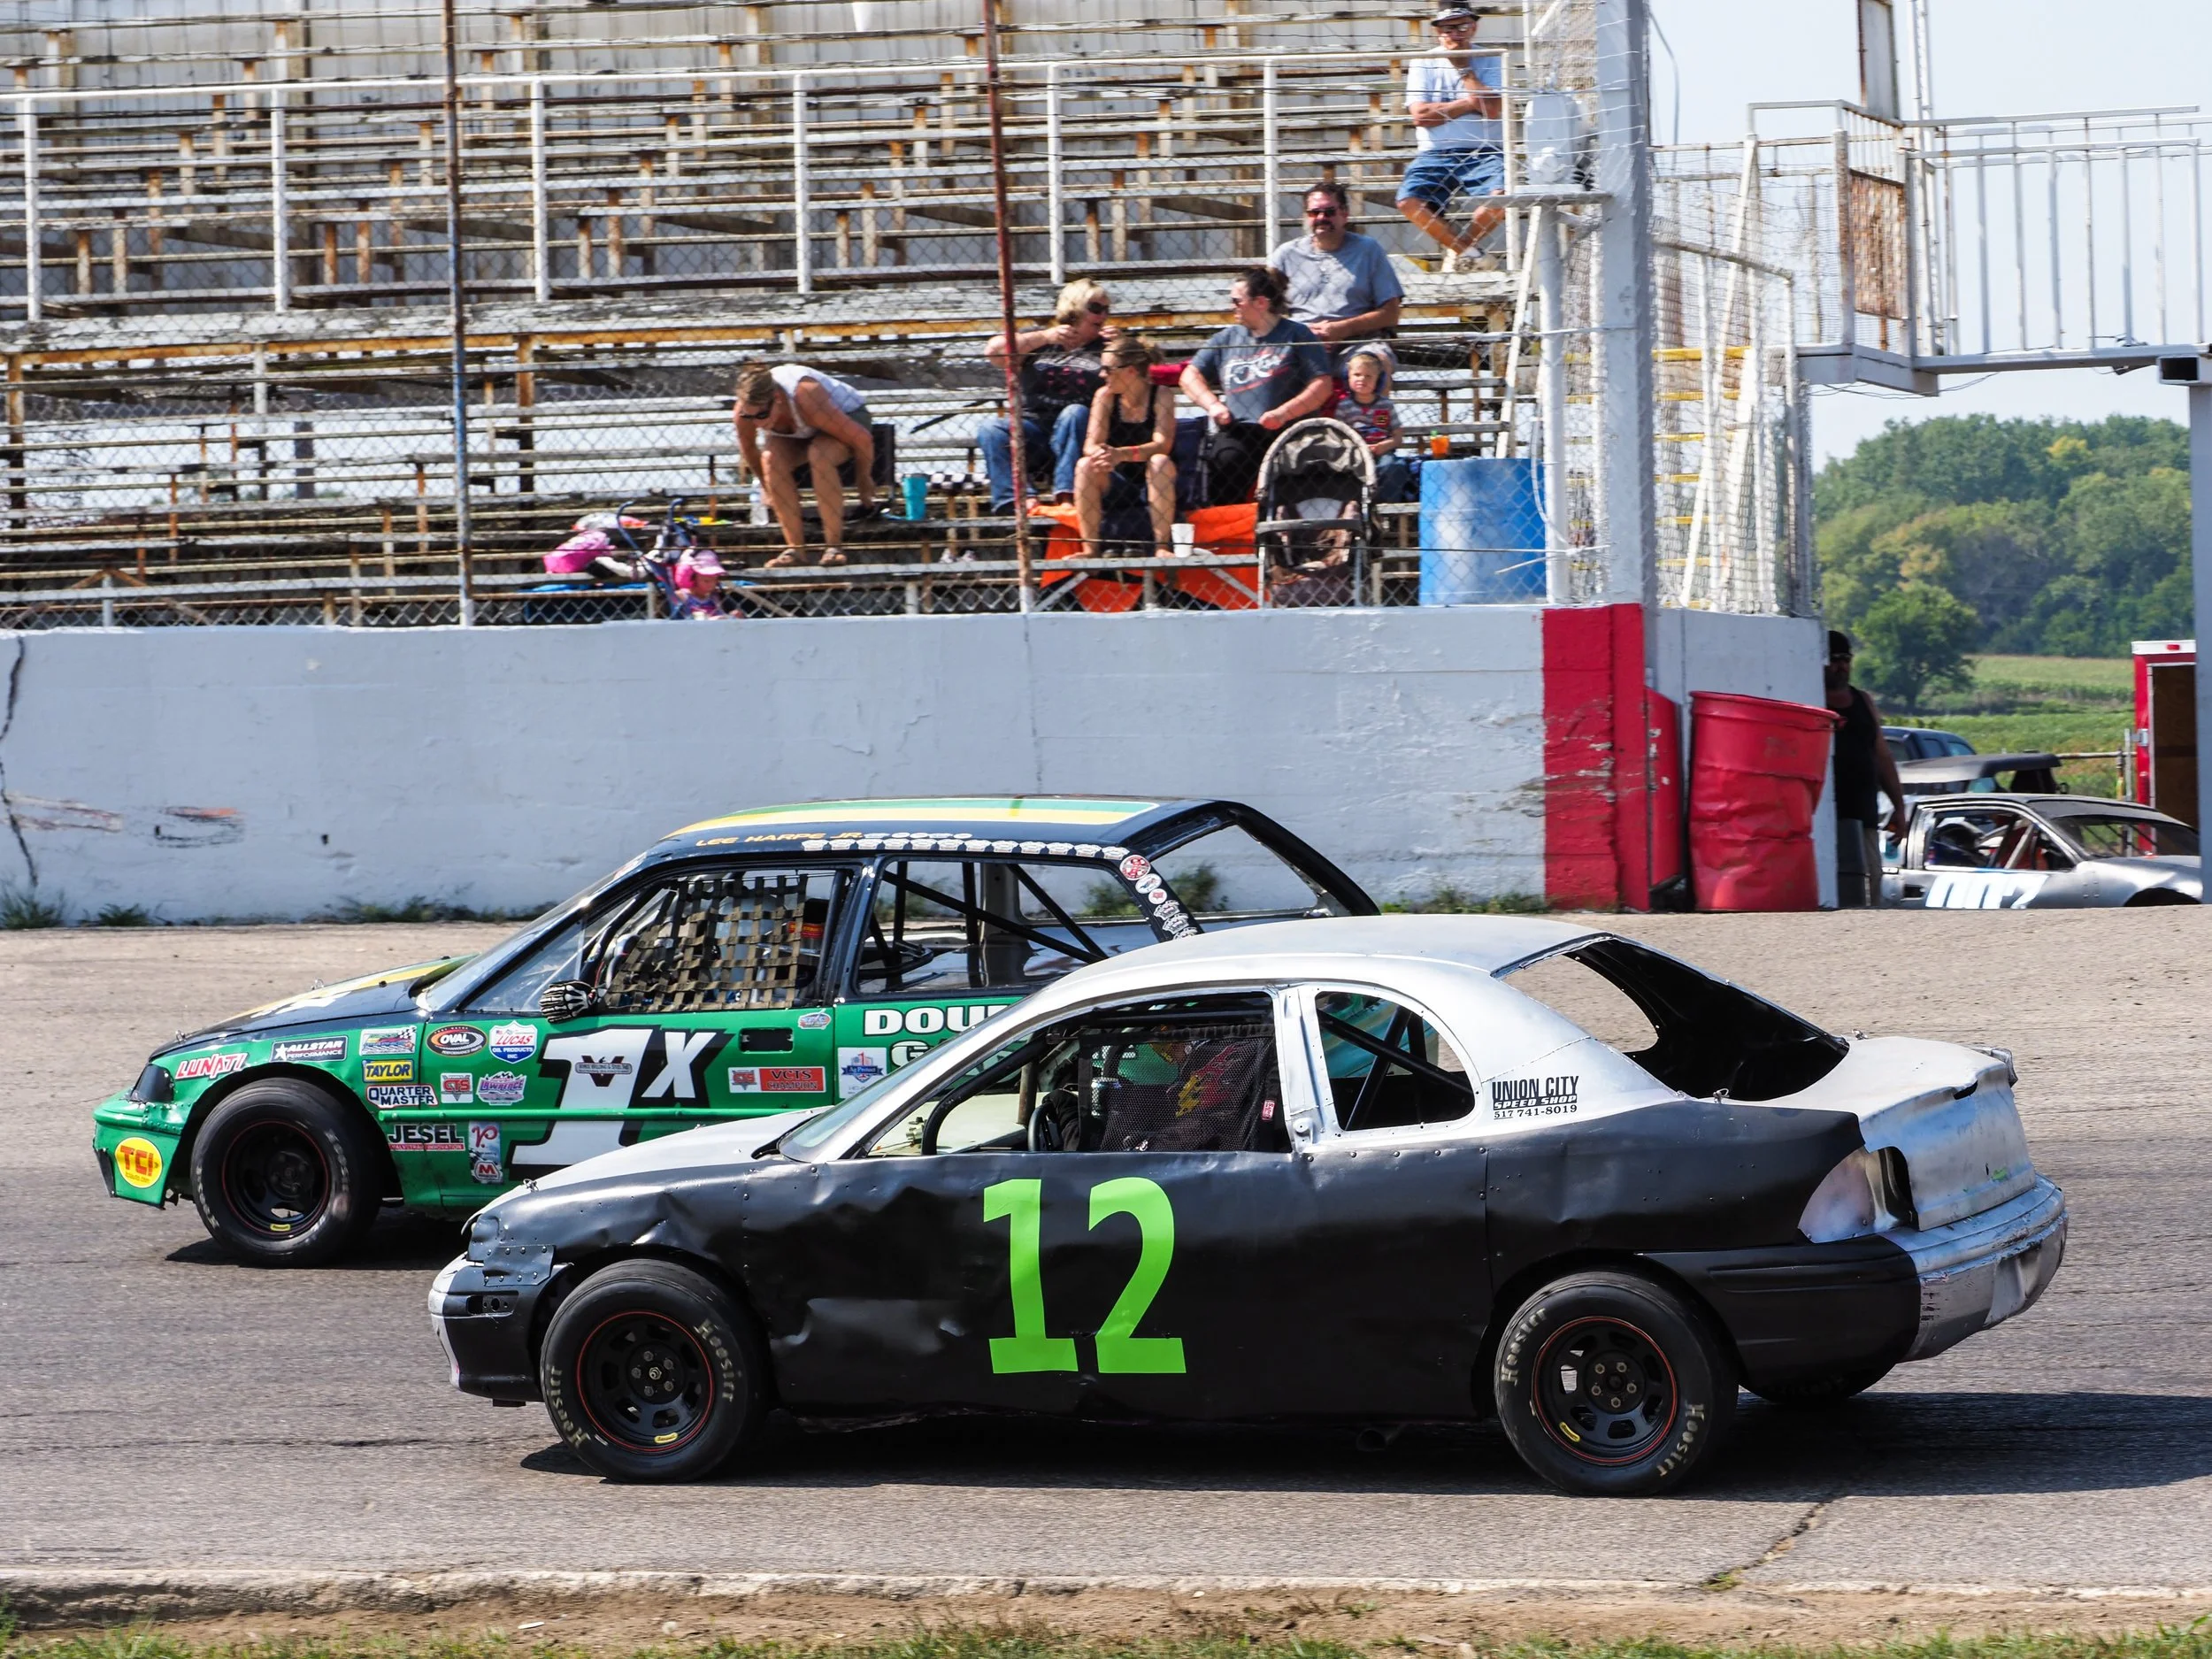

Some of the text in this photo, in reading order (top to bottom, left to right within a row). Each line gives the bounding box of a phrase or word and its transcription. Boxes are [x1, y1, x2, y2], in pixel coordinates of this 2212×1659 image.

[695, 836, 739, 847] LEE
[743, 833, 827, 842] HARPE
[864, 1005, 1008, 1035] DOU
[440, 1033, 470, 1044] OVAL
[495, 1035, 534, 1045] LUCAS
[287, 1040, 344, 1052] ALLSTAR
[287, 1049, 343, 1059] PERFORMANCE
[176, 1053, 248, 1079] LUNATI
[365, 1064, 411, 1078] TAYLOR
[771, 1070, 811, 1079] VCTS
[443, 1079, 471, 1092] CTS
[766, 1081, 818, 1090] CHAMPION
[1492, 1076, 1579, 1102] UNION CITY
[368, 1087, 432, 1101] QUARTER
[380, 1094, 435, 1106] MASTER
[1494, 1094, 1578, 1110] SPEED SHOP
[1494, 1104, 1578, 1119] 517 741-8019
[388, 1125, 464, 1143] JESEL
[120, 1145, 153, 1177] TCI
[983, 1177, 1187, 1373] 12
